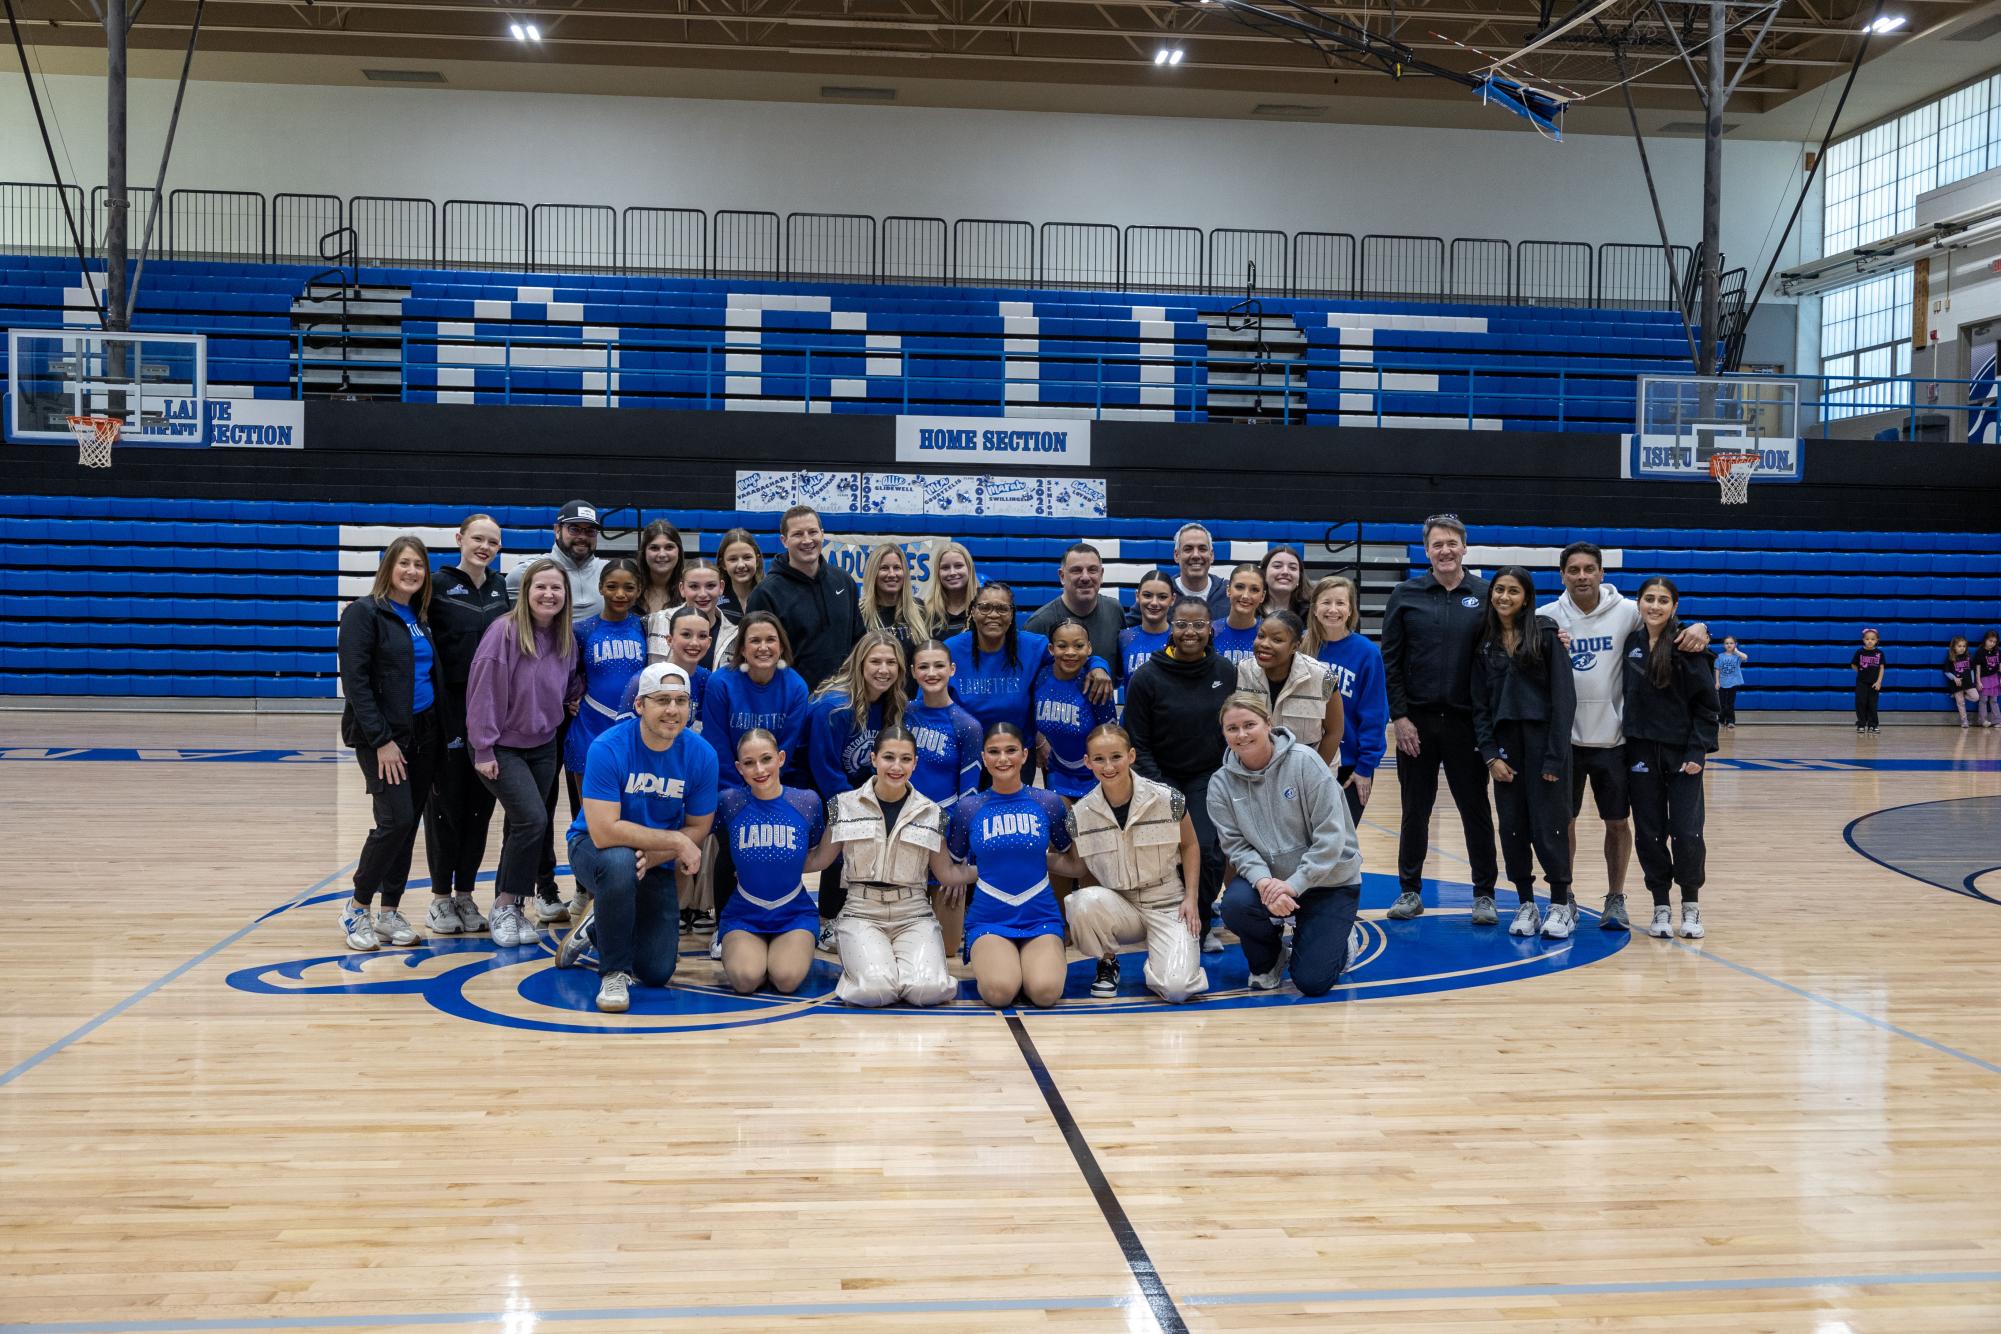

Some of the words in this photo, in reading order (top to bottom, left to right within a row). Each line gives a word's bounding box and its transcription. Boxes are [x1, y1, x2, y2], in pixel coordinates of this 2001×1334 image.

[919, 428, 977, 450] HOME
[983, 430, 1068, 452] SECTION
[849, 474, 859, 512] 2026
[862, 476, 872, 513] 2026
[975, 477, 984, 515] 2026
[1035, 479, 1045, 515] 2026
[593, 639, 643, 663] LADUE
[1569, 636, 1613, 654] ADUE
[1036, 700, 1080, 726] LADUE
[624, 772, 686, 799] LADUE
[738, 824, 797, 851] LADUE
[983, 813, 1042, 841] LADUE
